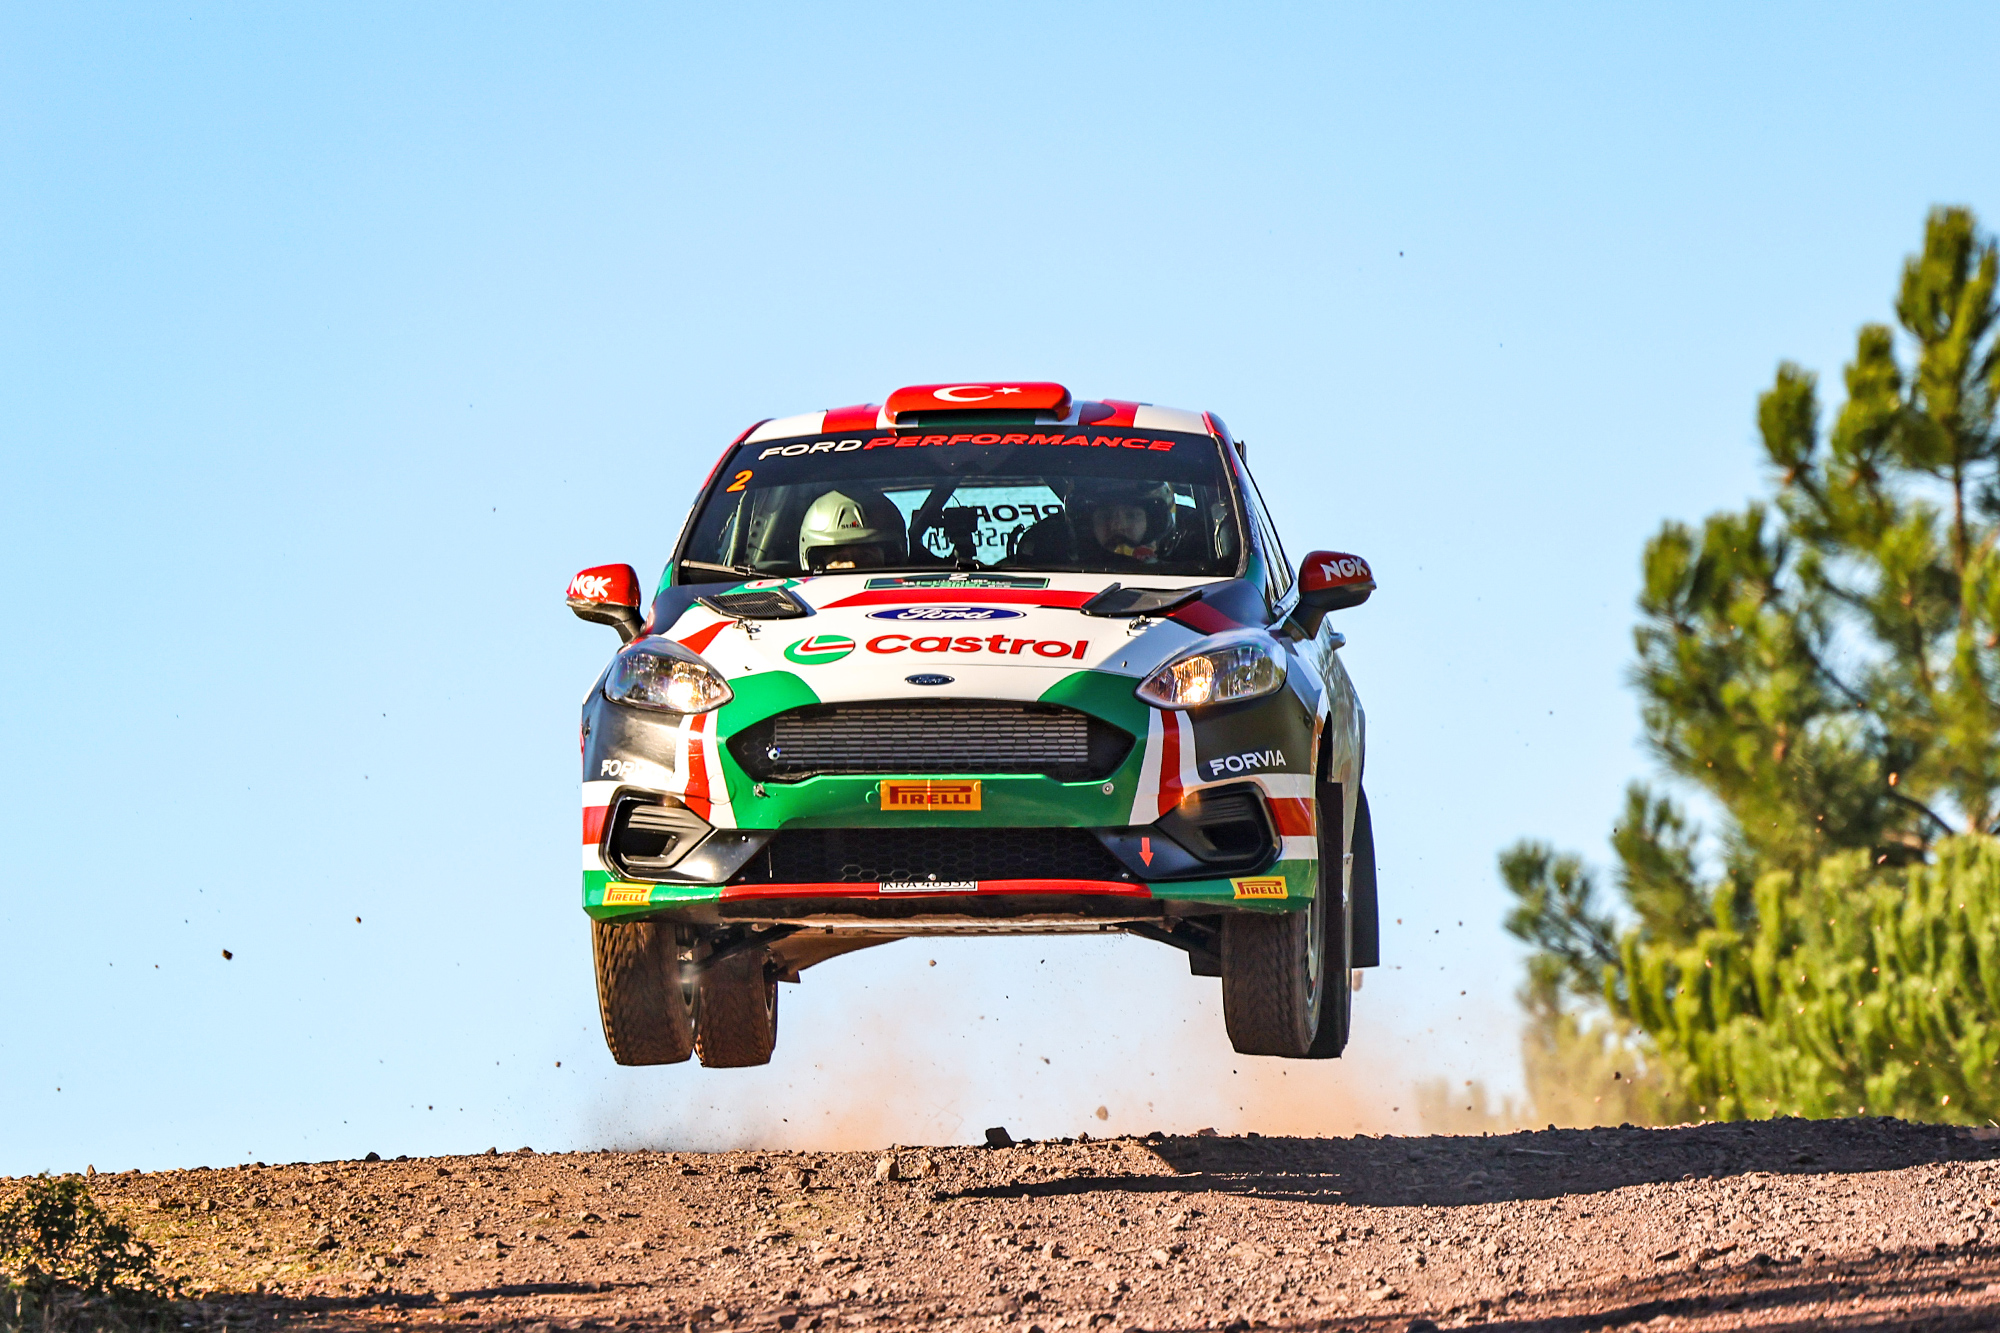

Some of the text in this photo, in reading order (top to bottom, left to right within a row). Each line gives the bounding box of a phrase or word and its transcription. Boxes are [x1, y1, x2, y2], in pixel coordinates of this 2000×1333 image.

[758, 433, 1176, 461] FORD PERFORMANCE
[726, 469, 754, 493] 2
[1320, 557, 1368, 582] NGK
[570, 574, 612, 598] NGK
[897, 607, 995, 620] Ford
[866, 633, 1089, 660] Castrol
[1209, 749, 1287, 776] FORVIA
[889, 785, 973, 805] PIRELLI
[606, 887, 648, 902] PIRELLI
[1236, 880, 1284, 896] PIRELLI
